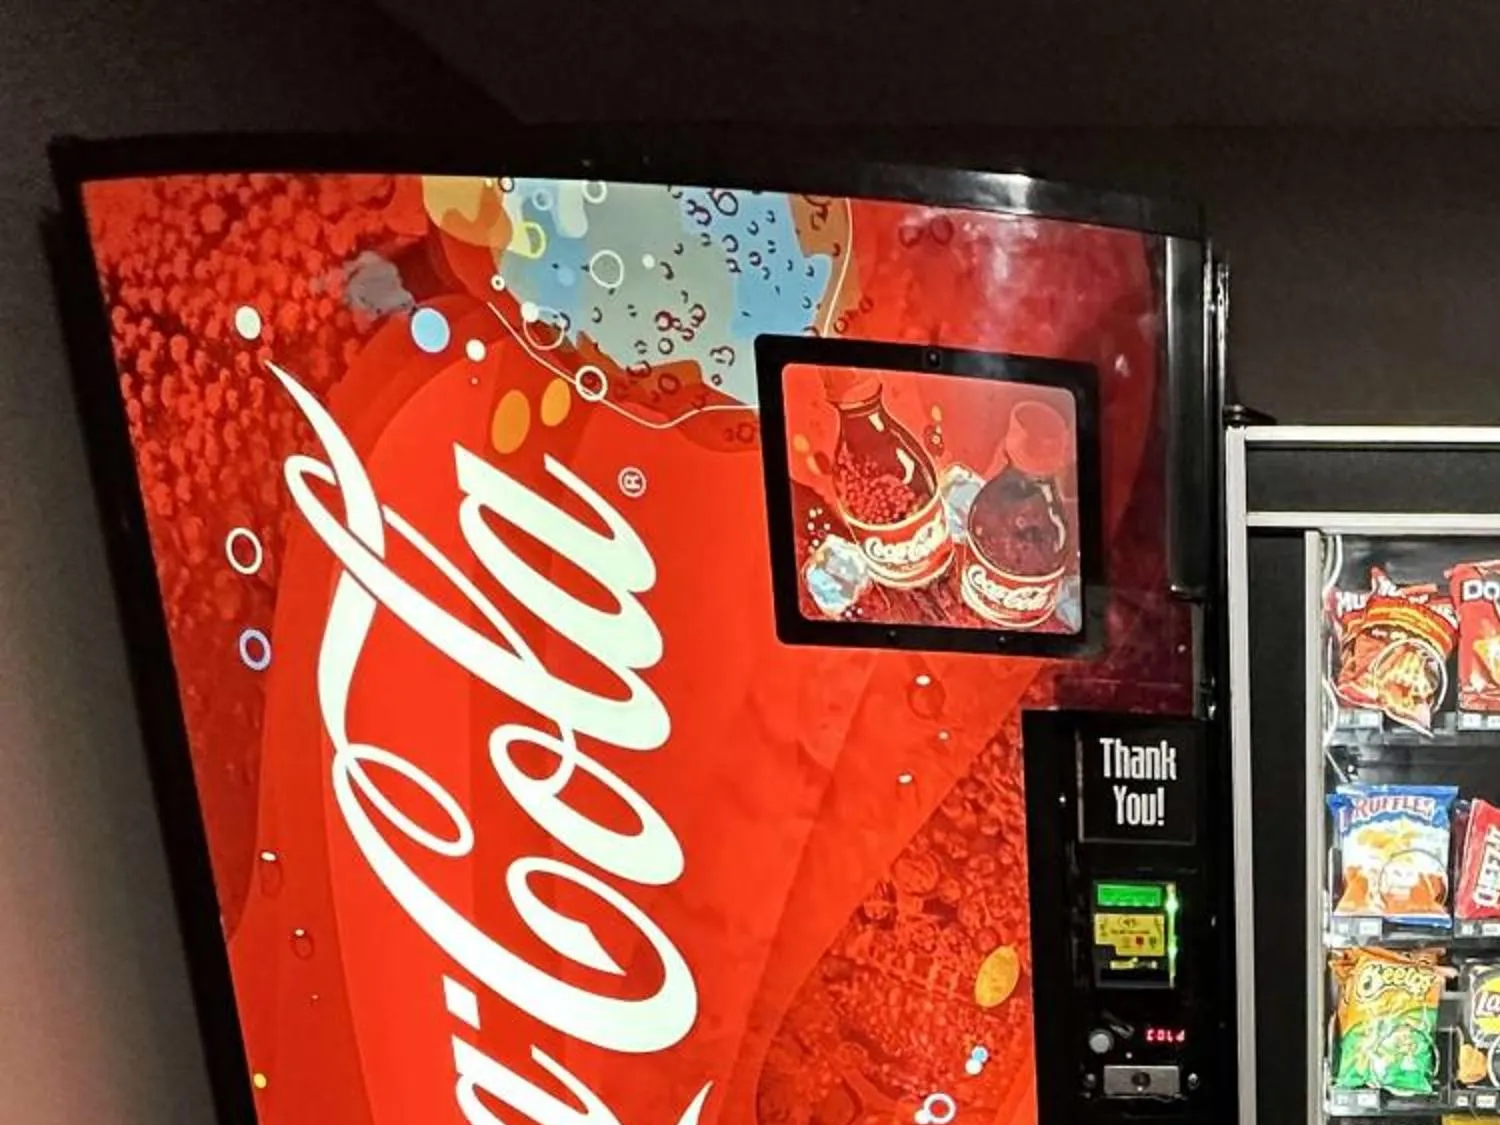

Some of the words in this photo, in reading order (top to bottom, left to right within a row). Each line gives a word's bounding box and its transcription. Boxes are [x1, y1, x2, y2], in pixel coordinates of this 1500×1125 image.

[1099, 737, 1177, 781] Thank
[1113, 785, 1165, 827] You!
[1350, 795, 1437, 821] RUFFLES
